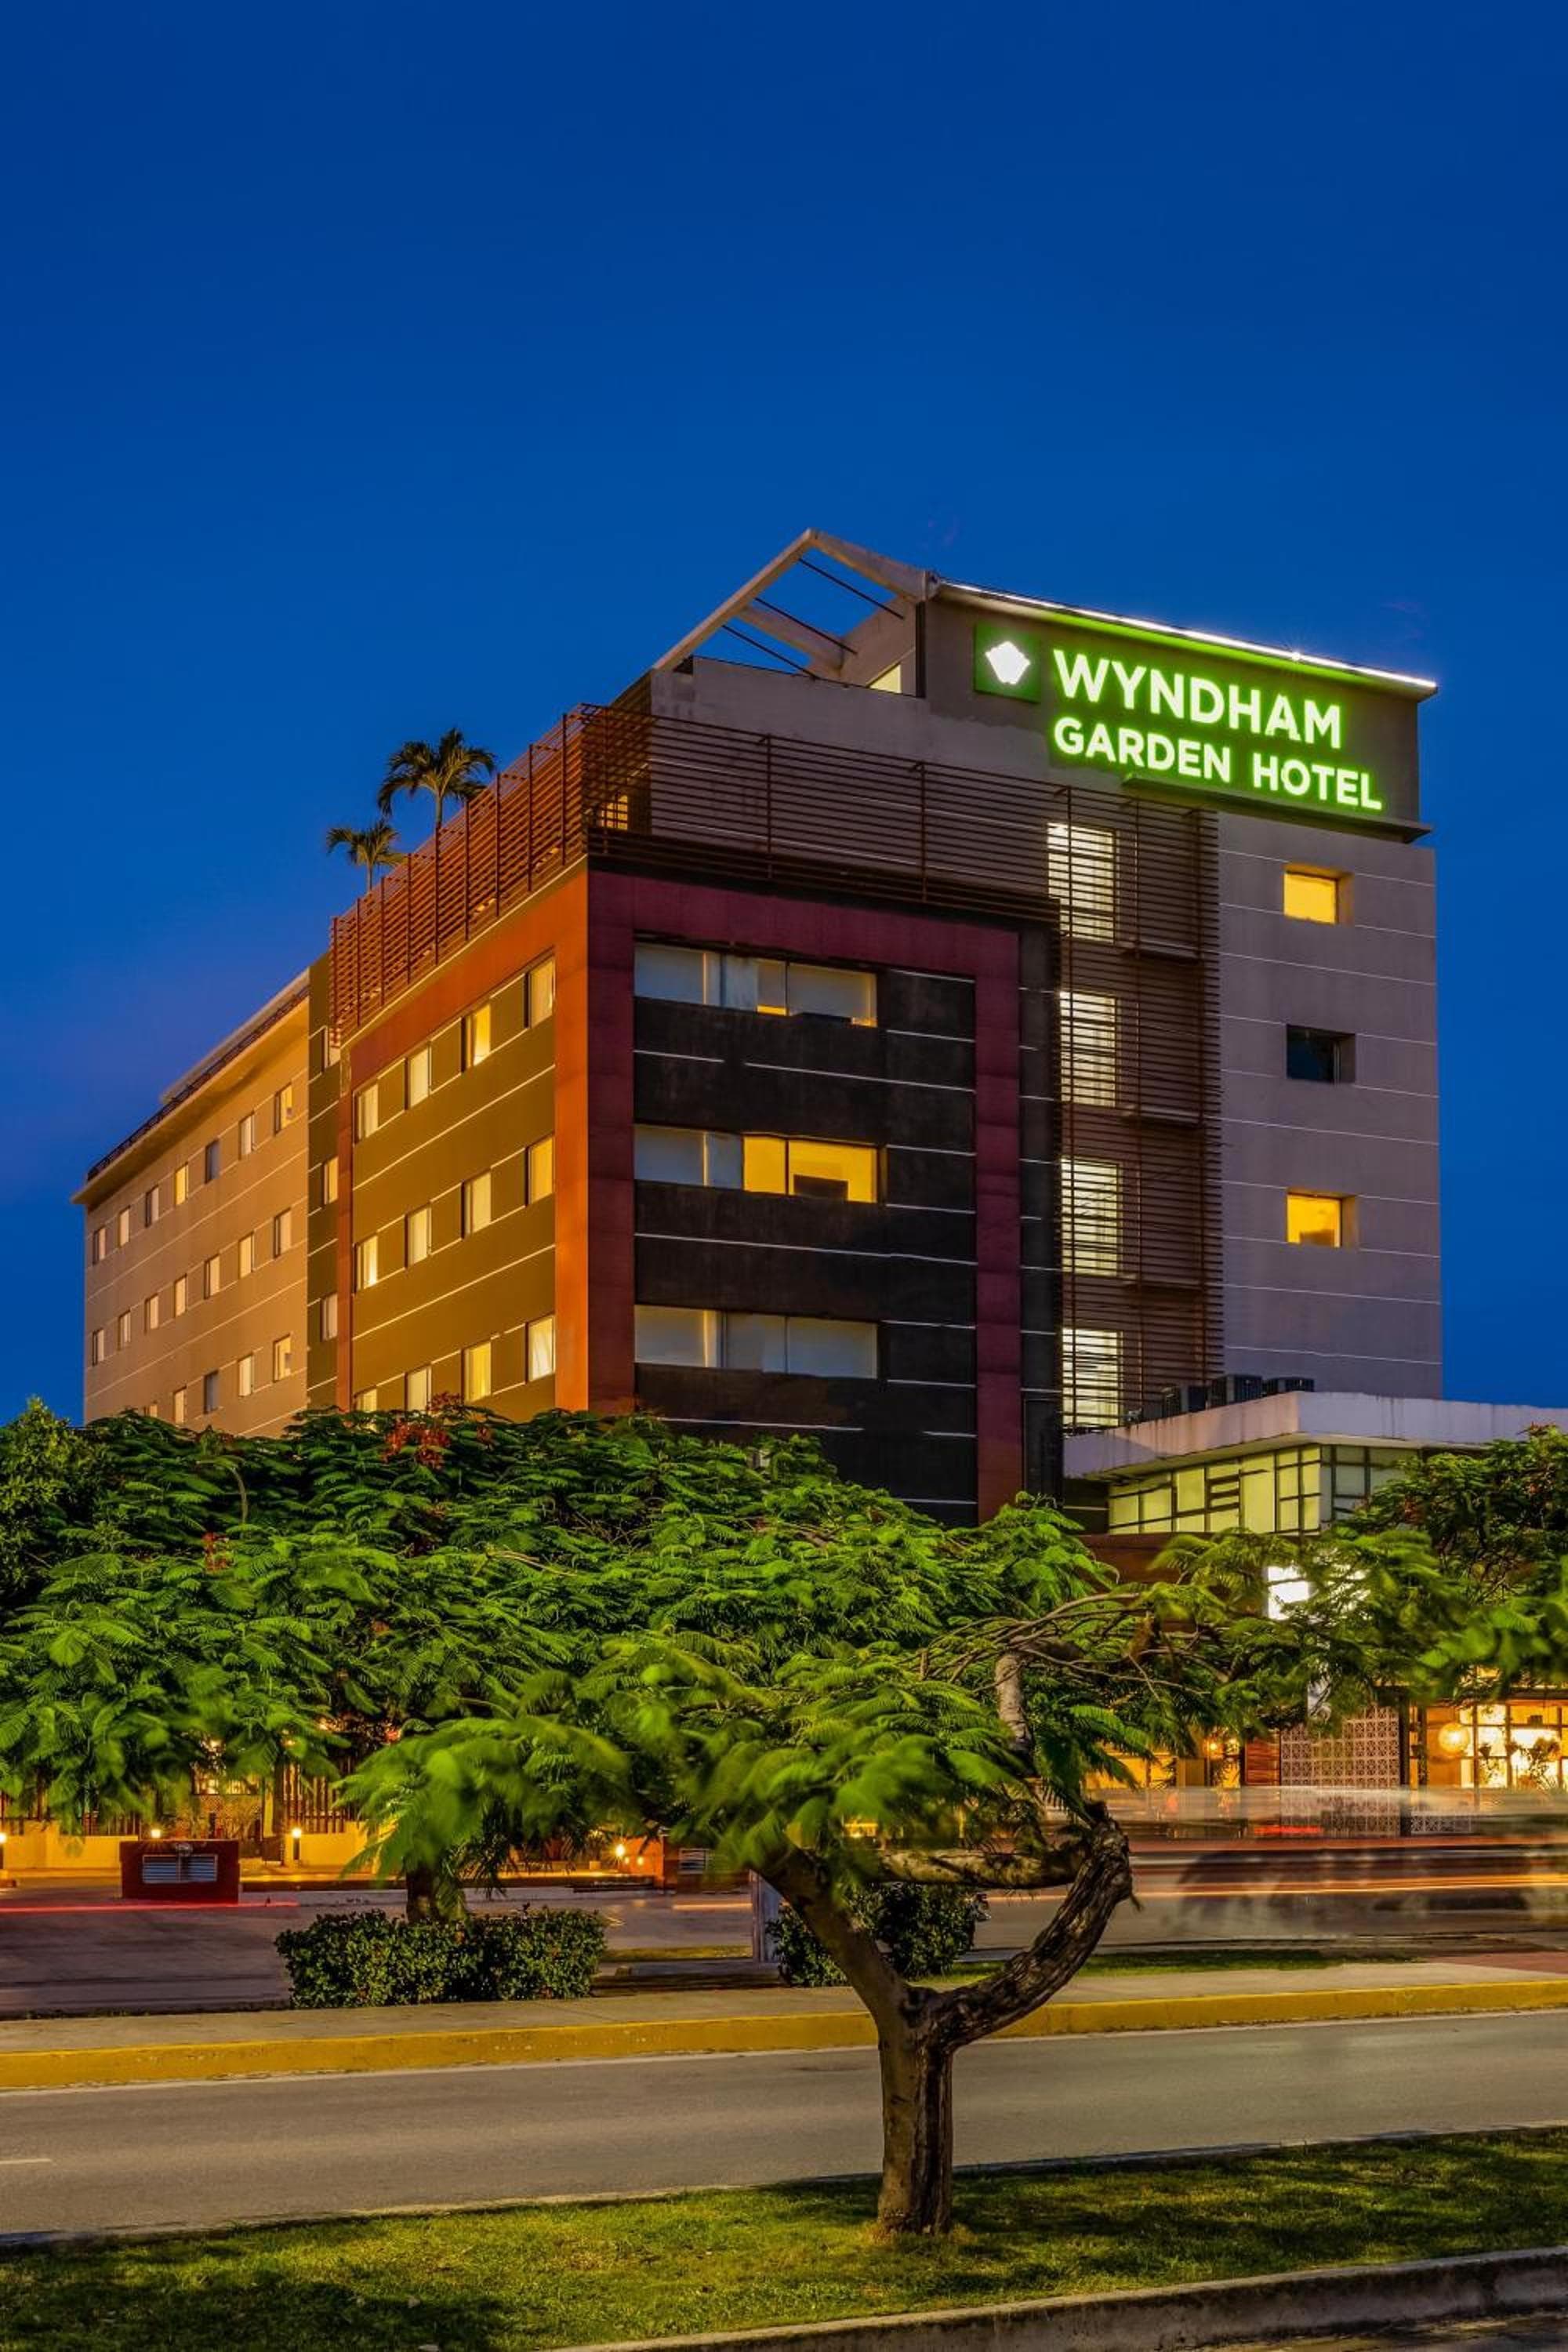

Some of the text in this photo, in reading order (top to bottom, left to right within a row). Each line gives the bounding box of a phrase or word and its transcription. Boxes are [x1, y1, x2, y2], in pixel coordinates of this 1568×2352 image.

[1053, 648, 1341, 749] WYNDHAM
[1054, 718, 1382, 811] GARDEN HOTEL
